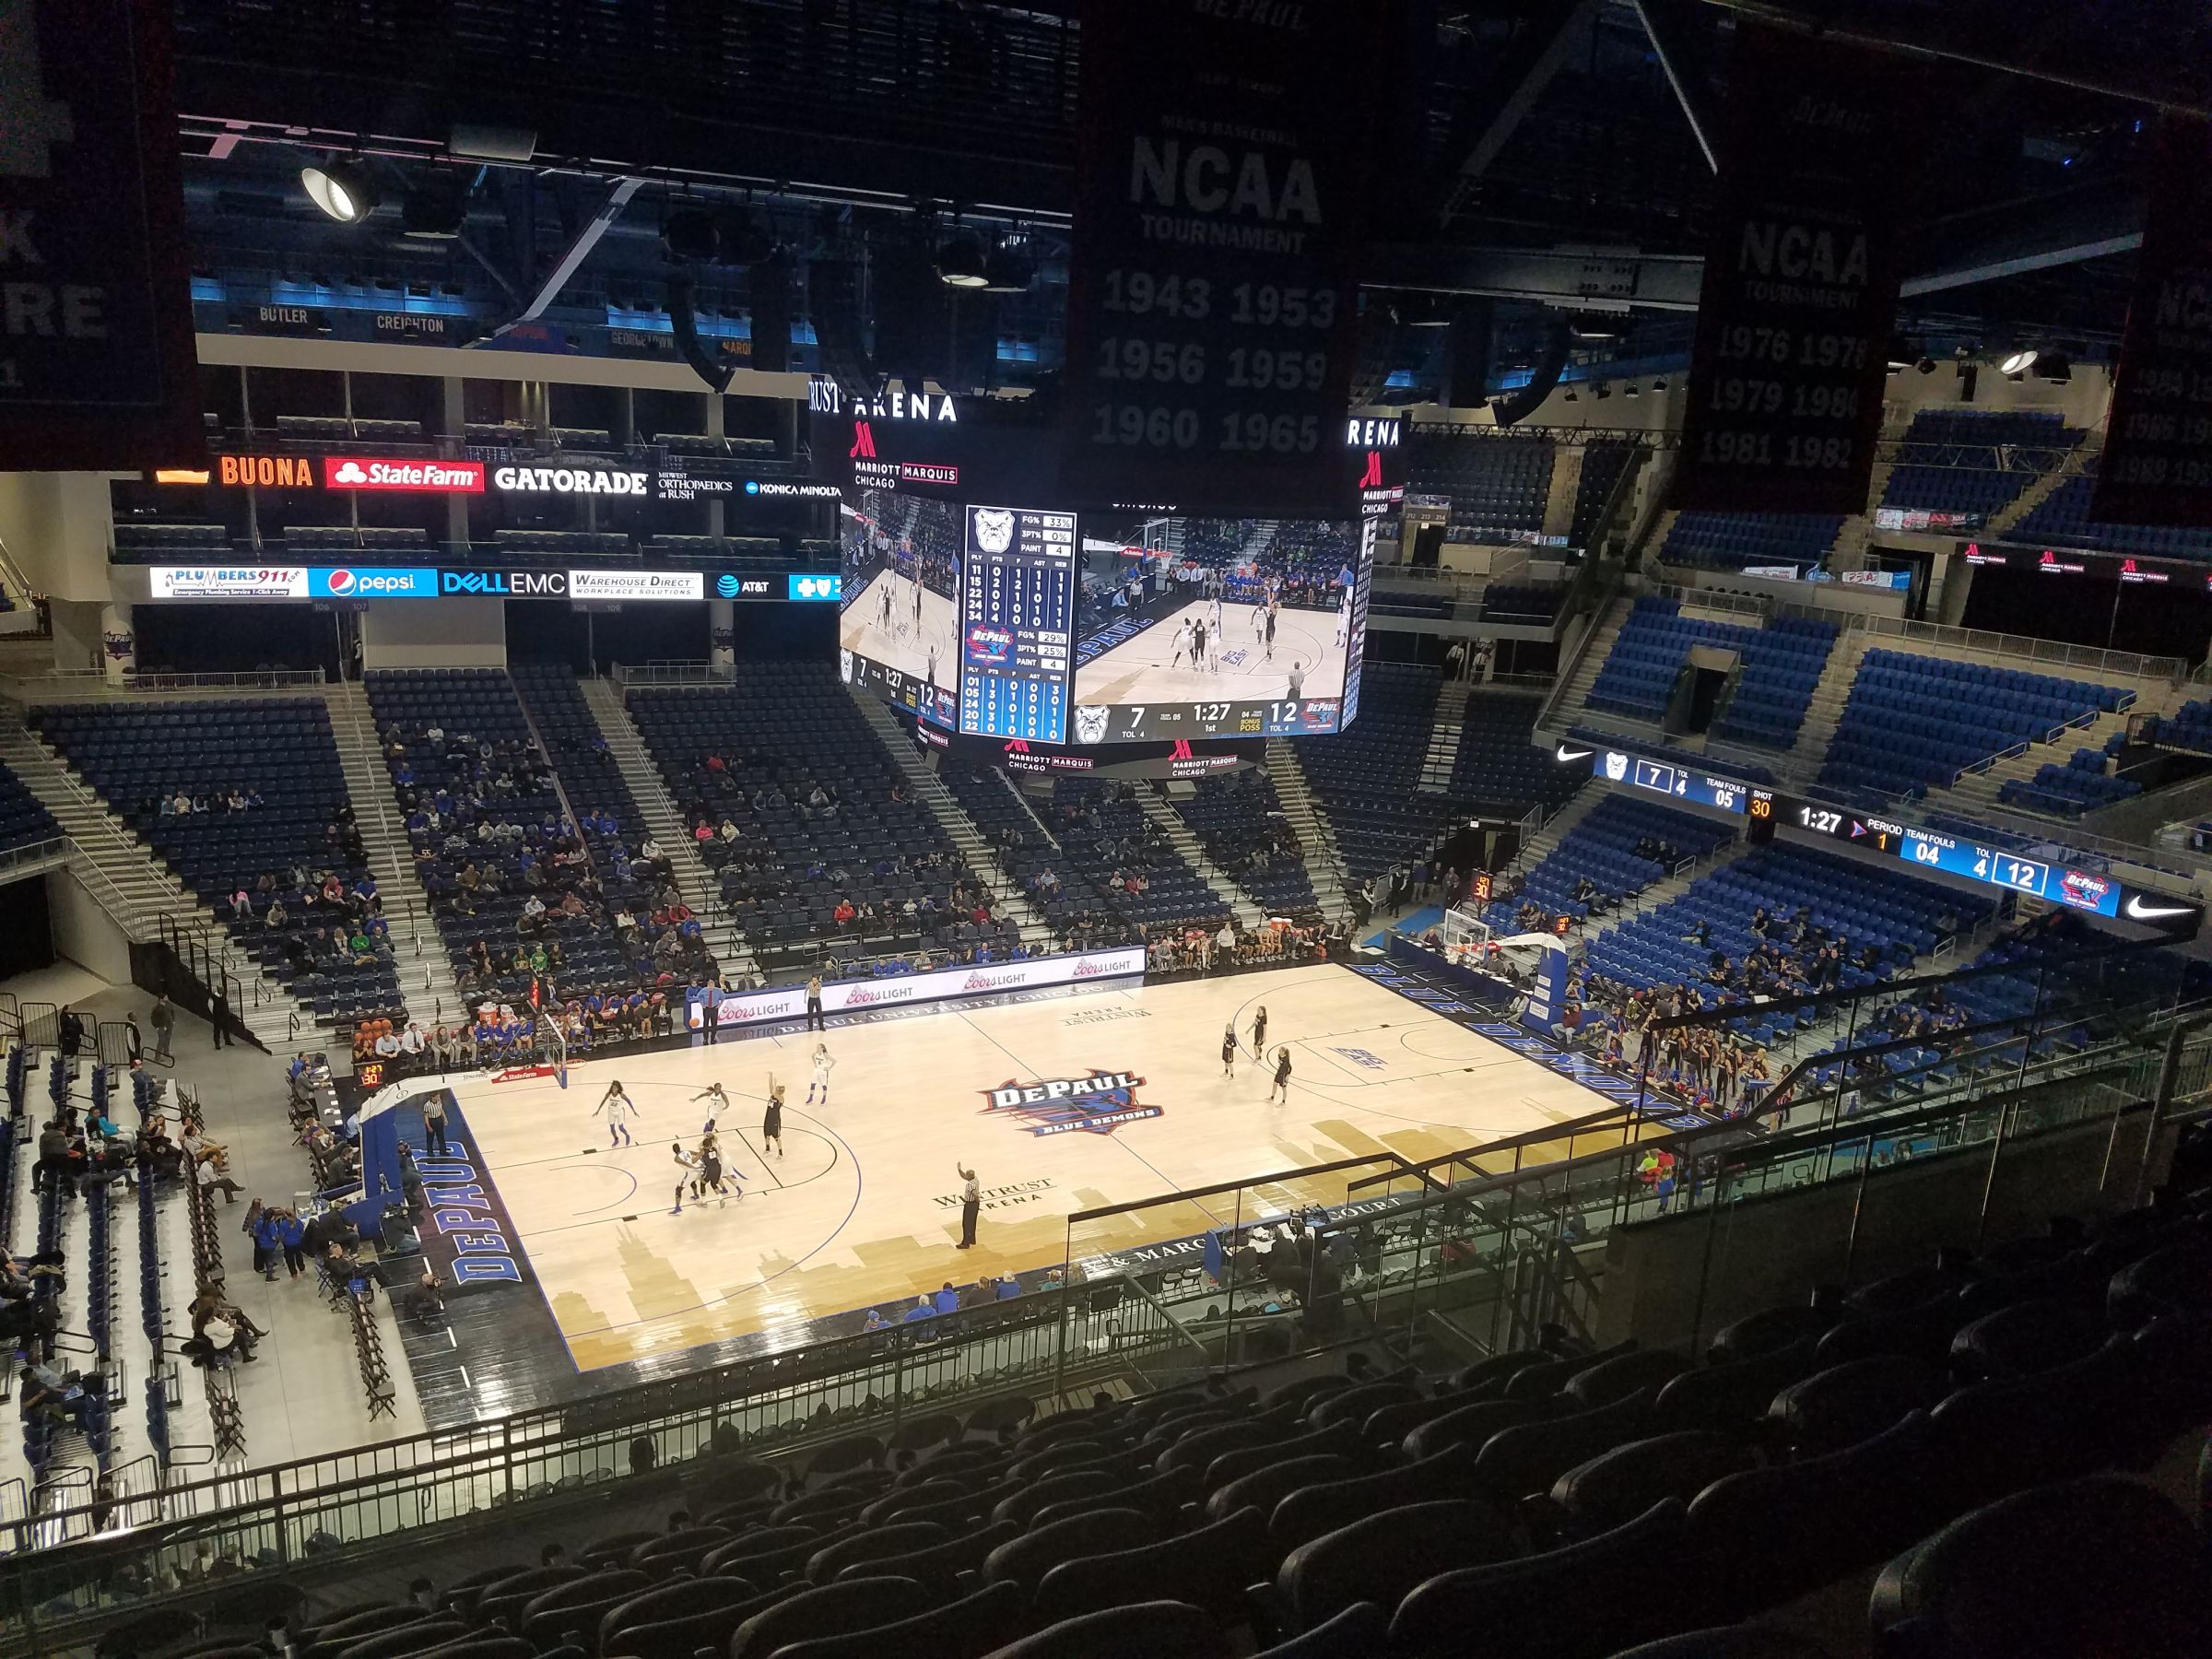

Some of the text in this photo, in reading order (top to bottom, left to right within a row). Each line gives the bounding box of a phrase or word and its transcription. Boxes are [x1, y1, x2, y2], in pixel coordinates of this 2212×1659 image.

[1131, 135, 1322, 224] NCAA
[1141, 213, 1306, 255] TOURNAMENT
[1738, 220, 1868, 286] NCAA
[1103, 269, 1335, 328] 1943 1953
[259, 307, 308, 325] BUTLER
[377, 315, 443, 333] CREIGHTON
[1719, 324, 1868, 370] 1976 1978
[1098, 337, 1327, 391] 1956 1959
[1710, 378, 1783, 413] 1979
[1092, 405, 1319, 453] 1960 1965
[1700, 430, 1771, 465] 1981
[221, 456, 312, 485] BUONA
[855, 462, 955, 480] MARRIOTT MARQUIS
[495, 467, 647, 495] GATORADE
[659, 478, 732, 490] ORTHOPAEDICS
[855, 476, 895, 488] CHICAGO
[668, 489, 694, 499] RUSH
[760, 484, 841, 496] KONICA MINOLTA
[1363, 490, 1392, 500] MARRIOTT
[1362, 504, 1387, 513] CHICAGO
[1050, 518, 1070, 527] 33%
[1052, 533, 1067, 541] 0%
[972, 565, 981, 574] 11
[359, 574, 415, 594] pepsi
[444, 573, 562, 594] DELL EMC
[575, 576, 692, 588] WAREHOUSE DIRECT
[742, 581, 770, 593] AT&T
[971, 577, 981, 586] 15
[969, 589, 982, 597] 22
[315, 603, 329, 611] 106
[353, 603, 367, 611] 107
[1044, 634, 1064, 642] 29%
[1044, 648, 1064, 656] 25%
[1017, 658, 1036, 666] PAINT
[861, 658, 934, 708] 7 1:27 12
[1131, 707, 1145, 728] 7
[1194, 704, 1230, 721] 1:27
[1271, 703, 1297, 723] 12
[1008, 761, 1046, 771] CHICAGO
[1009, 753, 1092, 767] MARRIOTT MARQUIS
[1172, 756, 1238, 769] MARRIOTT MARQUIS
[1650, 769, 1661, 785] 7
[1678, 770, 1688, 778] TOL
[1676, 780, 1686, 794] 4
[1707, 778, 1746, 794] TEAM FOULS
[1715, 790, 1733, 807] 05
[1754, 790, 1772, 801] SHOT
[1752, 800, 1770, 817] 30
[1801, 807, 1841, 833] 1:27
[1868, 818, 1902, 835] PERIOD
[1879, 833, 1887, 850] 1
[1906, 829, 1955, 848] TEAM FOULS
[422, 849, 430, 857] 55
[1916, 843, 1939, 864] 04
[1976, 847, 1990, 858] TOL
[1973, 860, 1987, 877] 4
[2008, 862, 2035, 888] 12
[1477, 883, 1488, 900] 30
[1074, 960, 1131, 977] Coors LIGHT
[965, 973, 1026, 989] Coors LIGHT
[846, 987, 912, 1005] Coors LIGHT
[868, 985, 1103, 1021] UNIVERSITY CHICAGO
[719, 1003, 790, 1020] Coors LIGHT
[1346, 963, 1711, 1129] BLUE DEMONS
[1043, 1109, 1155, 1134] BLUE DEMONS
[415, 1141, 523, 1285] DEPAUL
[1328, 1197, 1402, 1221] COURT
[1111, 1256, 1131, 1267] &
